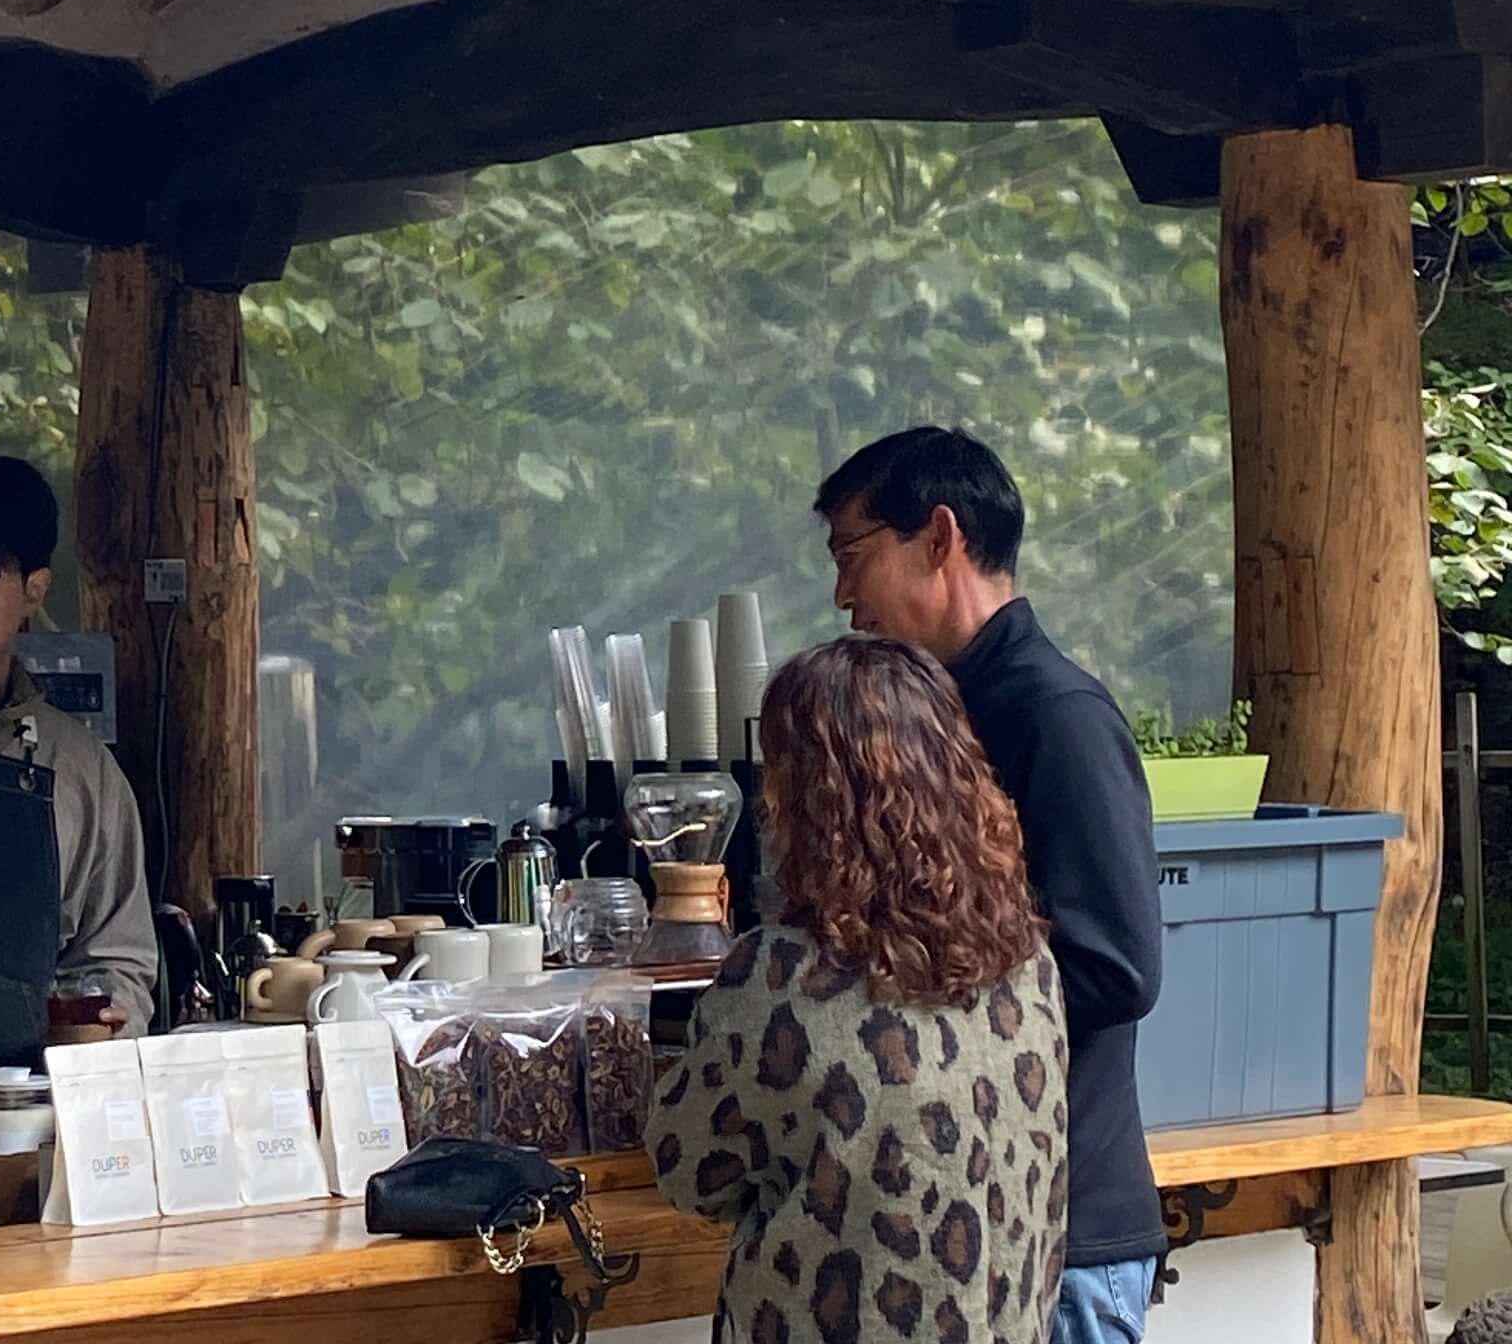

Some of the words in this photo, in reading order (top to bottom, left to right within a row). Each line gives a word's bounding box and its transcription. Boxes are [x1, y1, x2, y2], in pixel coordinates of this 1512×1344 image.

[1158, 867, 1189, 885] UTE
[180, 1144, 217, 1162] DUPER
[257, 1136, 296, 1153] DUPER
[92, 1155, 130, 1172] DUPER
